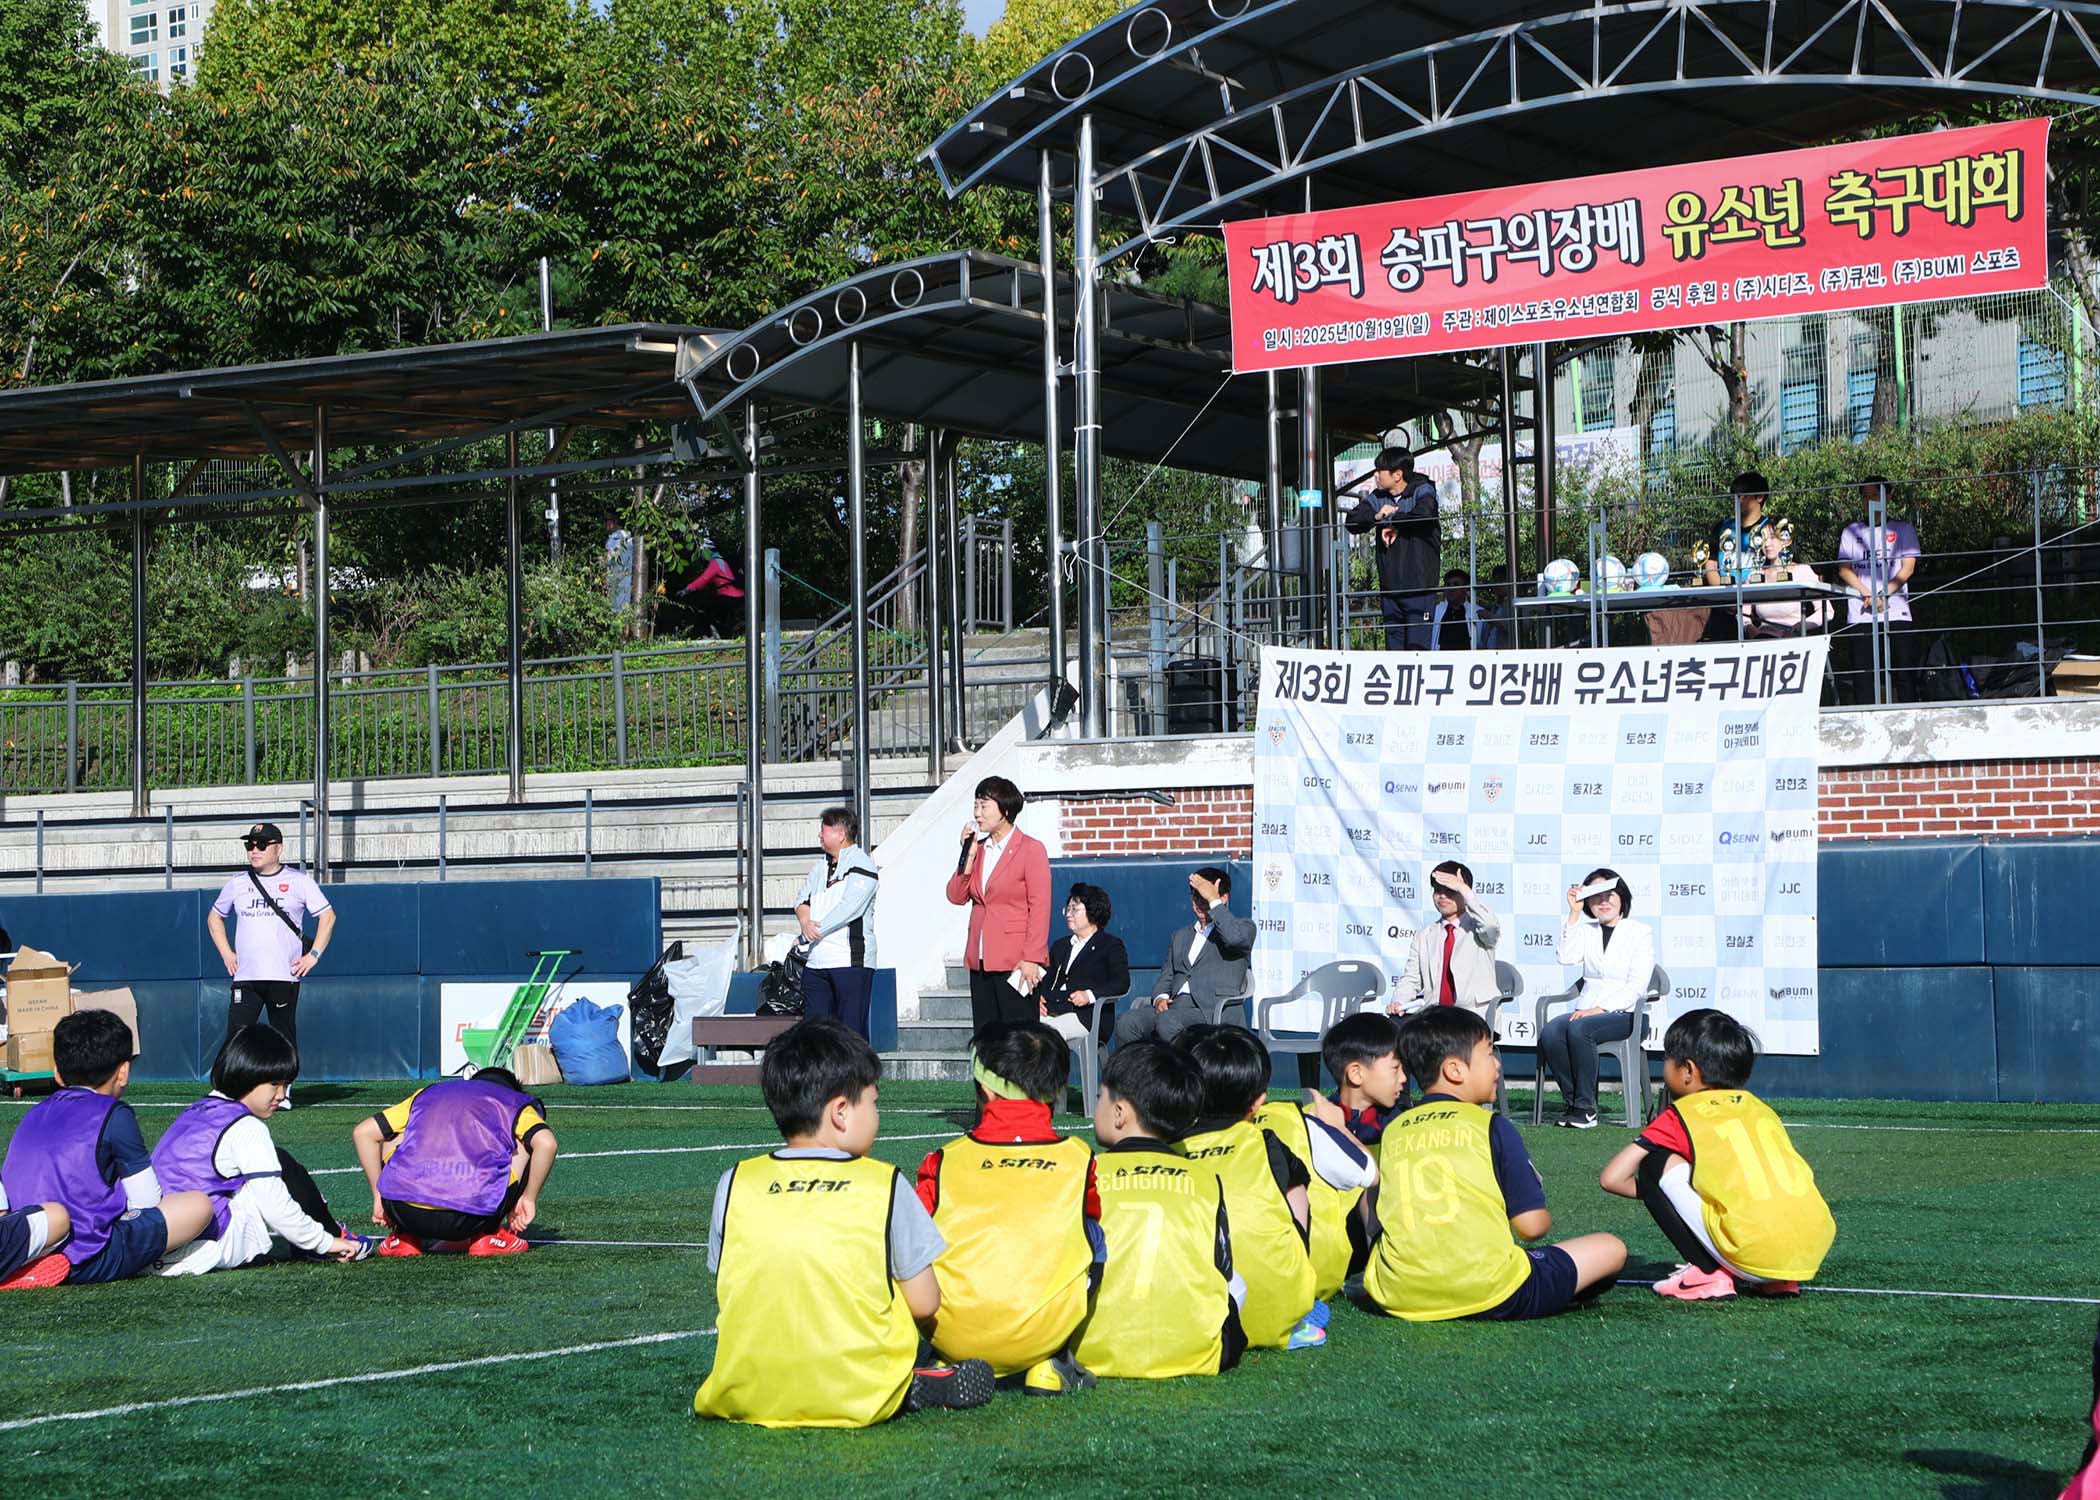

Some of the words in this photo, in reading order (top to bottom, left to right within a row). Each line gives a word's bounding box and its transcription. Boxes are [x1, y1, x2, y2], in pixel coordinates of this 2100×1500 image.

[1250, 234, 1363, 303] 제3회
[1380, 198, 1645, 293] 송파구의장배
[1662, 178, 1806, 262] 유소년
[1825, 148, 2025, 240] 축구대회
[1652, 286, 1682, 309] 공식
[1687, 281, 1717, 304] 후원
[1894, 256, 1966, 285] (주)BUMI
[1970, 247, 2021, 274] 스포츠
[1274, 659, 1352, 704] 제3회
[1364, 663, 1455, 706] 송파구
[1465, 661, 1563, 706] 의장배
[1574, 650, 1811, 705] 유소년축구대회
[1626, 732, 1657, 745] 토성초
[1441, 781, 1466, 790] BUMI
[1528, 833, 1547, 845] JJC
[1618, 834, 1634, 846] GD
[1639, 834, 1654, 846] FC
[1785, 829, 1813, 838] BUMI
[1392, 871, 1410, 883] 대지
[1475, 881, 1505, 895] 잠실초
[1669, 883, 1707, 896] 강동FC
[1778, 882, 1801, 894] JJC
[1345, 924, 1373, 936] SIDIZ
[1387, 925, 1417, 939] QSEN
[1523, 933, 1554, 946] 신자초
[1726, 935, 1755, 948] 잠실초
[1675, 987, 1707, 999] SIDIZ
[1785, 987, 1813, 996] BUMI
[1508, 1021, 1537, 1038] (주)
[1713, 1117, 1809, 1201] 10
[787, 1179, 851, 1193] star
[1394, 1154, 1462, 1232] 19
[489, 1237, 507, 1248] FILA
[1117, 1200, 1165, 1300] 7
